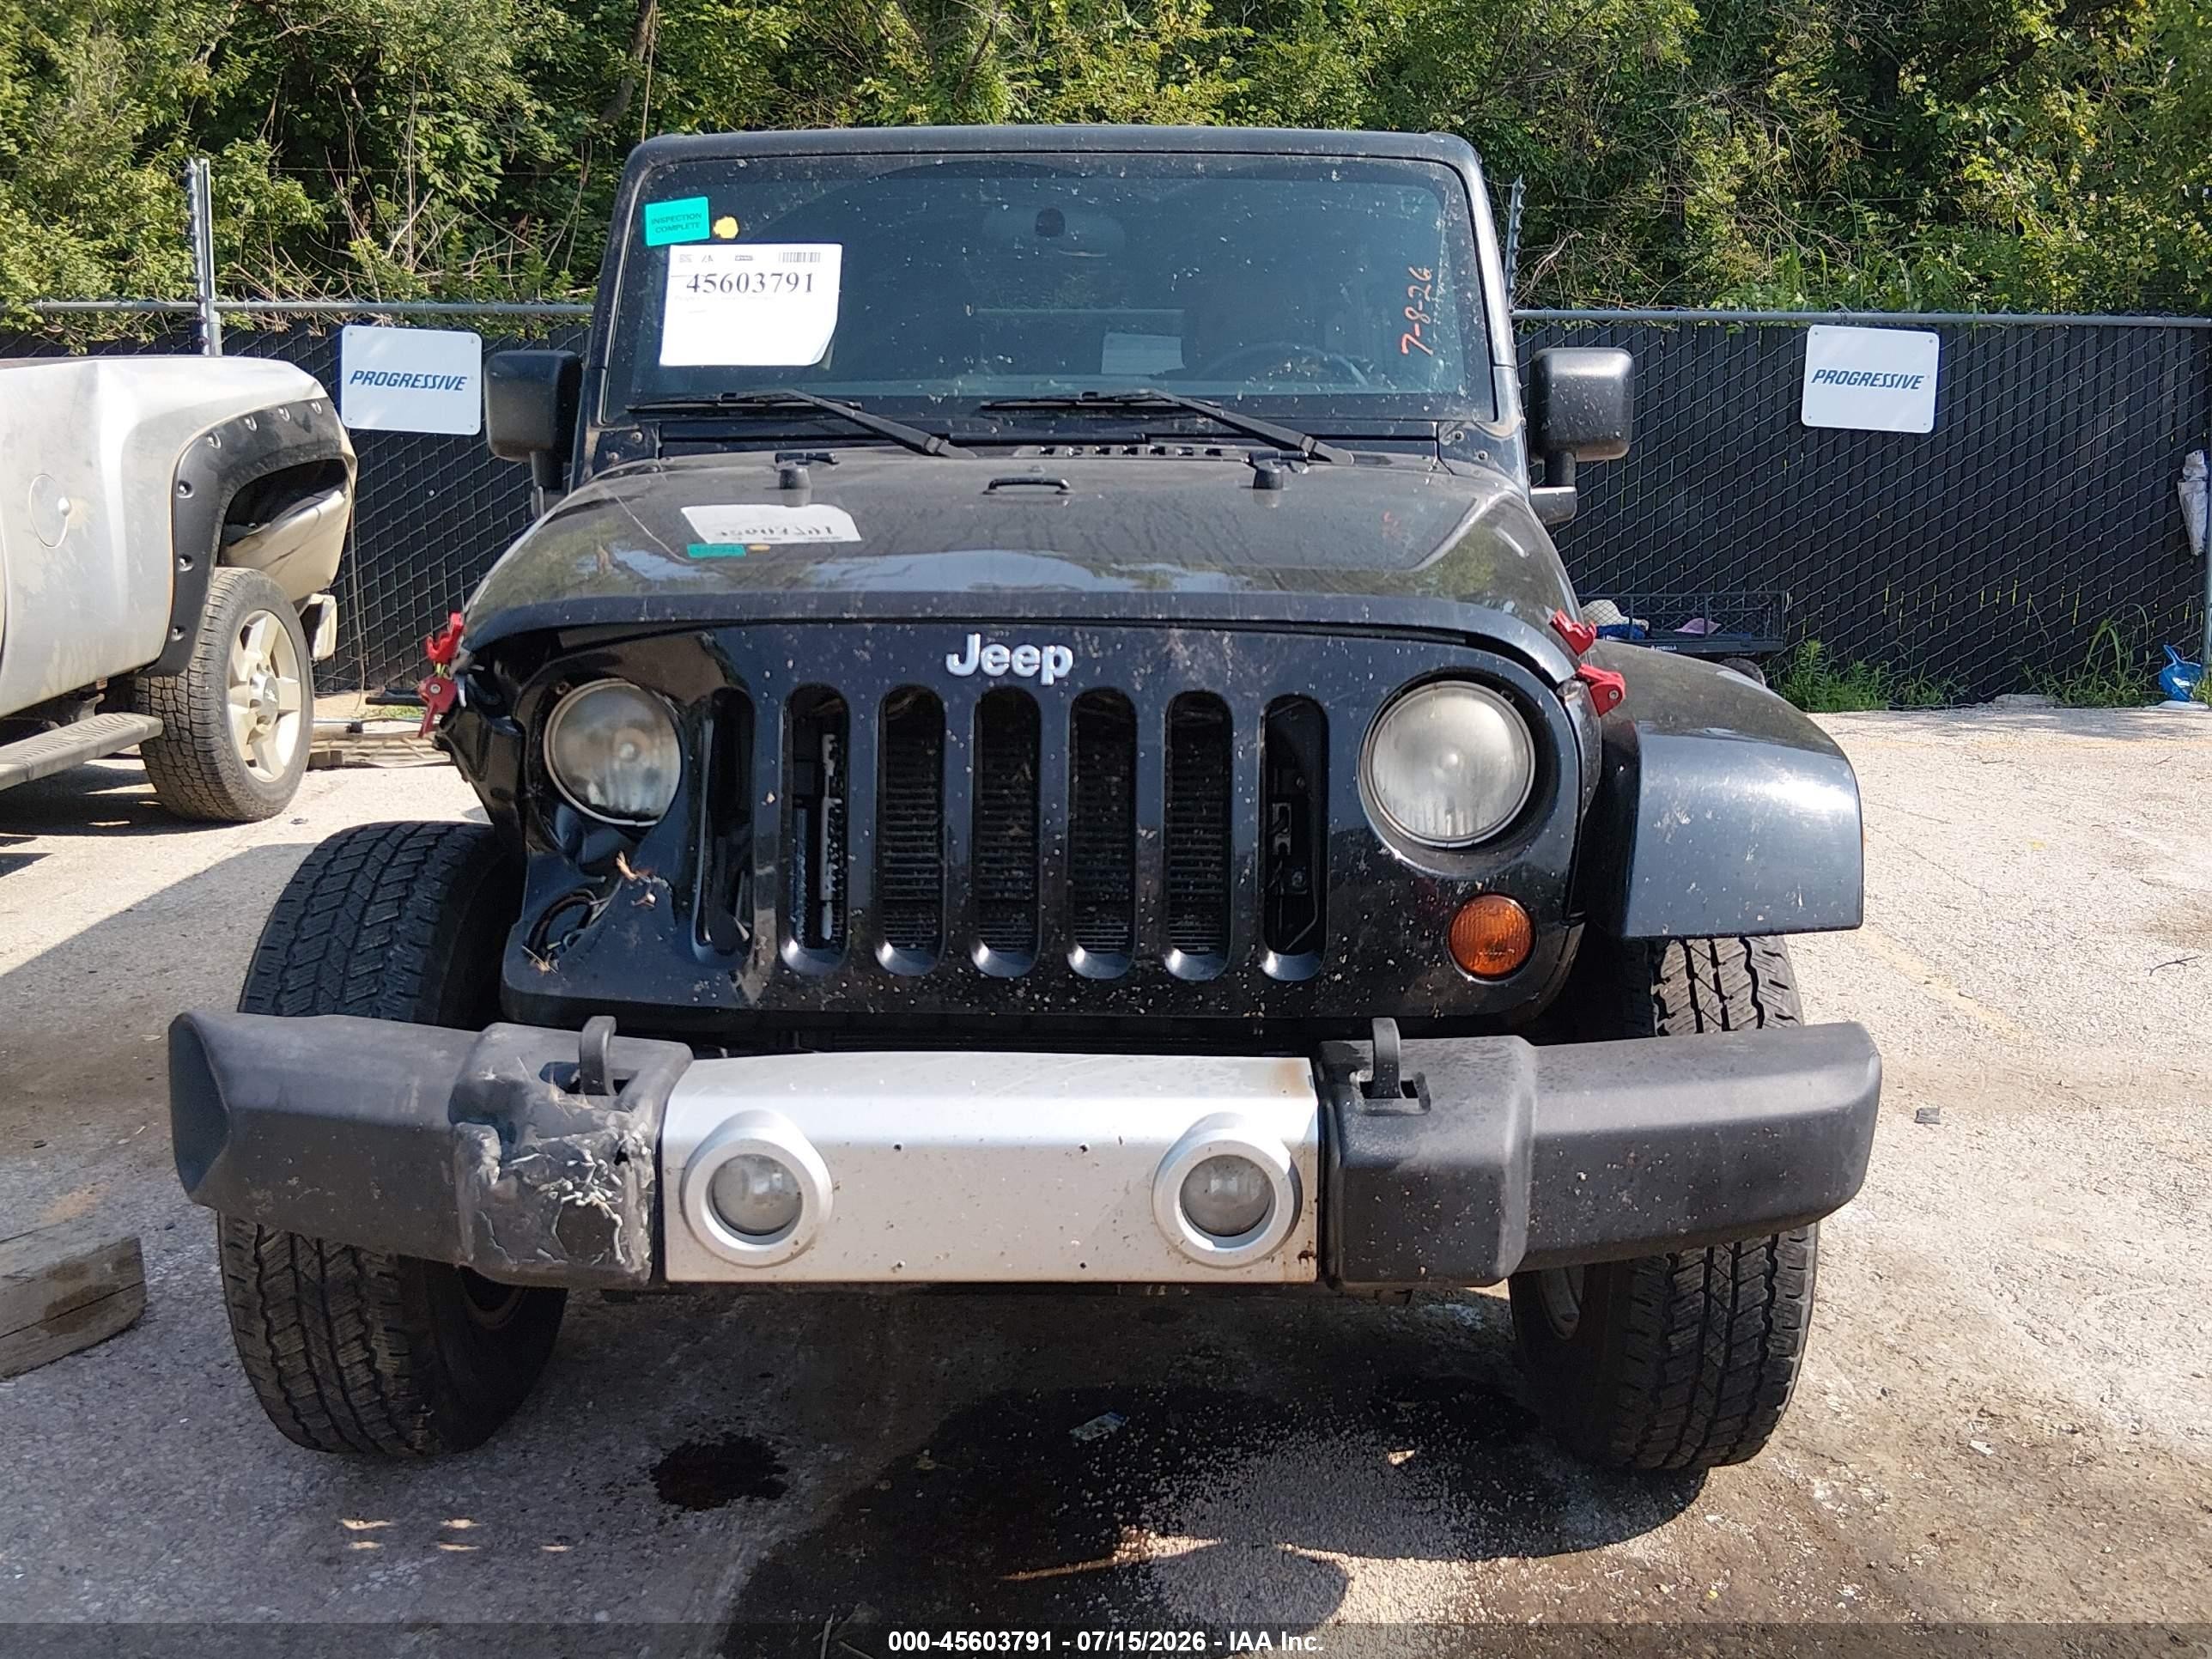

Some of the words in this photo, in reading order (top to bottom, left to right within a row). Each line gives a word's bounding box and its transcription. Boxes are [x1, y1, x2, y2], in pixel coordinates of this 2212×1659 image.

[651, 213, 702, 225] INSPECTION
[655, 222, 701, 234] COMPLETE
[686, 272, 814, 294] 45603791
[1401, 265, 1434, 356] 7-8-26
[349, 370, 467, 391] PROGRESSIVE
[1811, 369, 1924, 390] PROGRESSIVE
[945, 632, 1073, 686] Jeep
